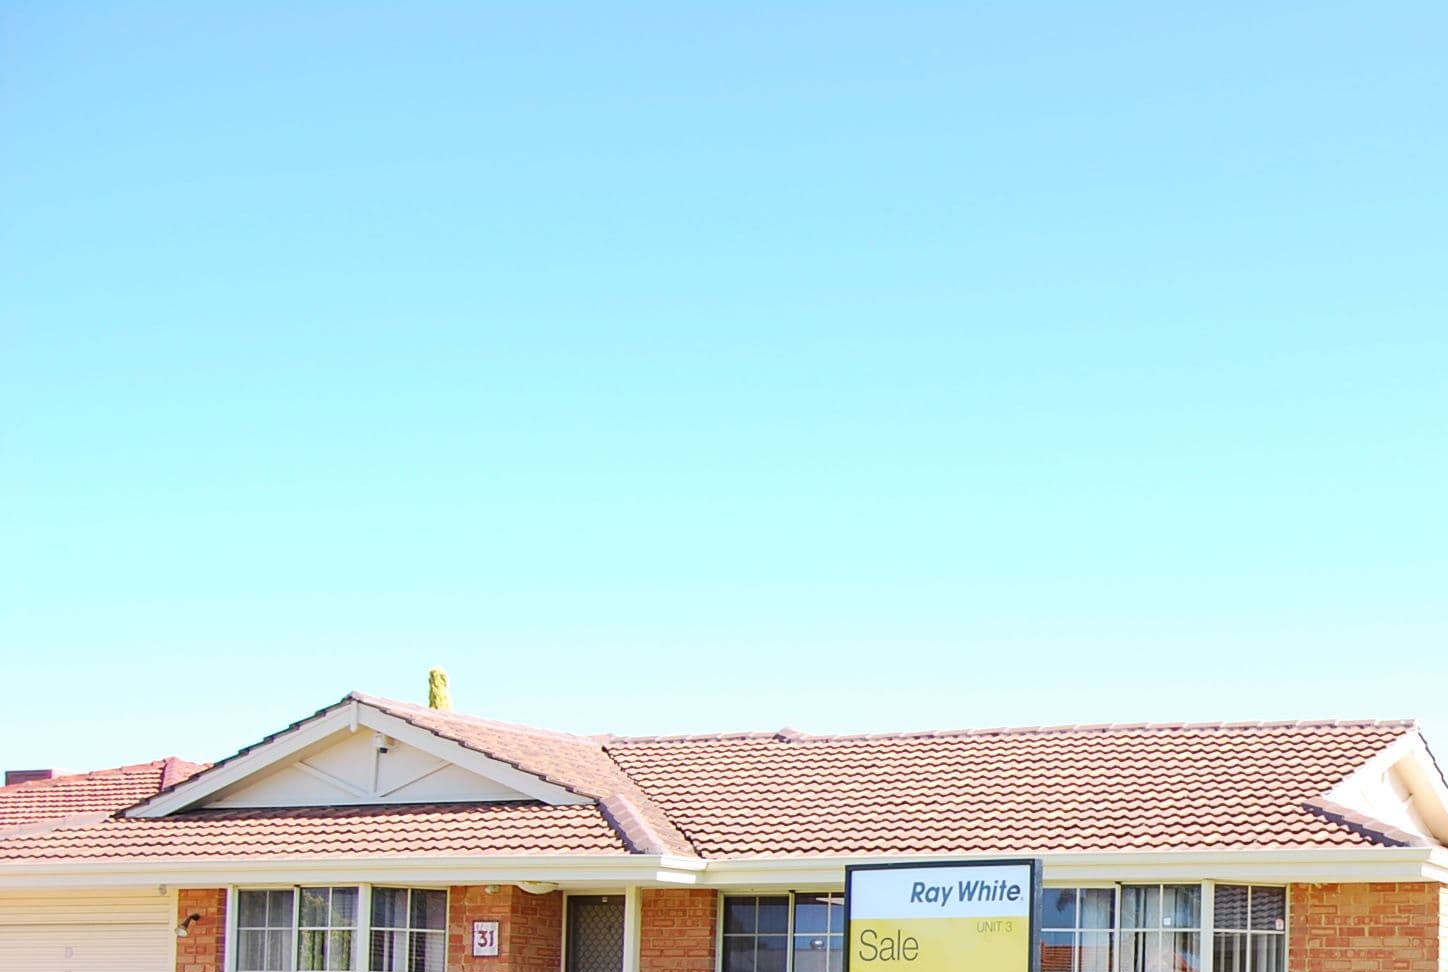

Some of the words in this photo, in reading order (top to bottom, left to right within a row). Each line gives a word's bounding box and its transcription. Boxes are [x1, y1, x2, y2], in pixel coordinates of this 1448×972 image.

[910, 881, 953, 907] Ray
[958, 879, 1021, 902] White
[976, 921, 1002, 933] UNIT
[1004, 920, 1013, 933] 3
[477, 930, 494, 947] 31
[859, 929, 919, 962] Sale
